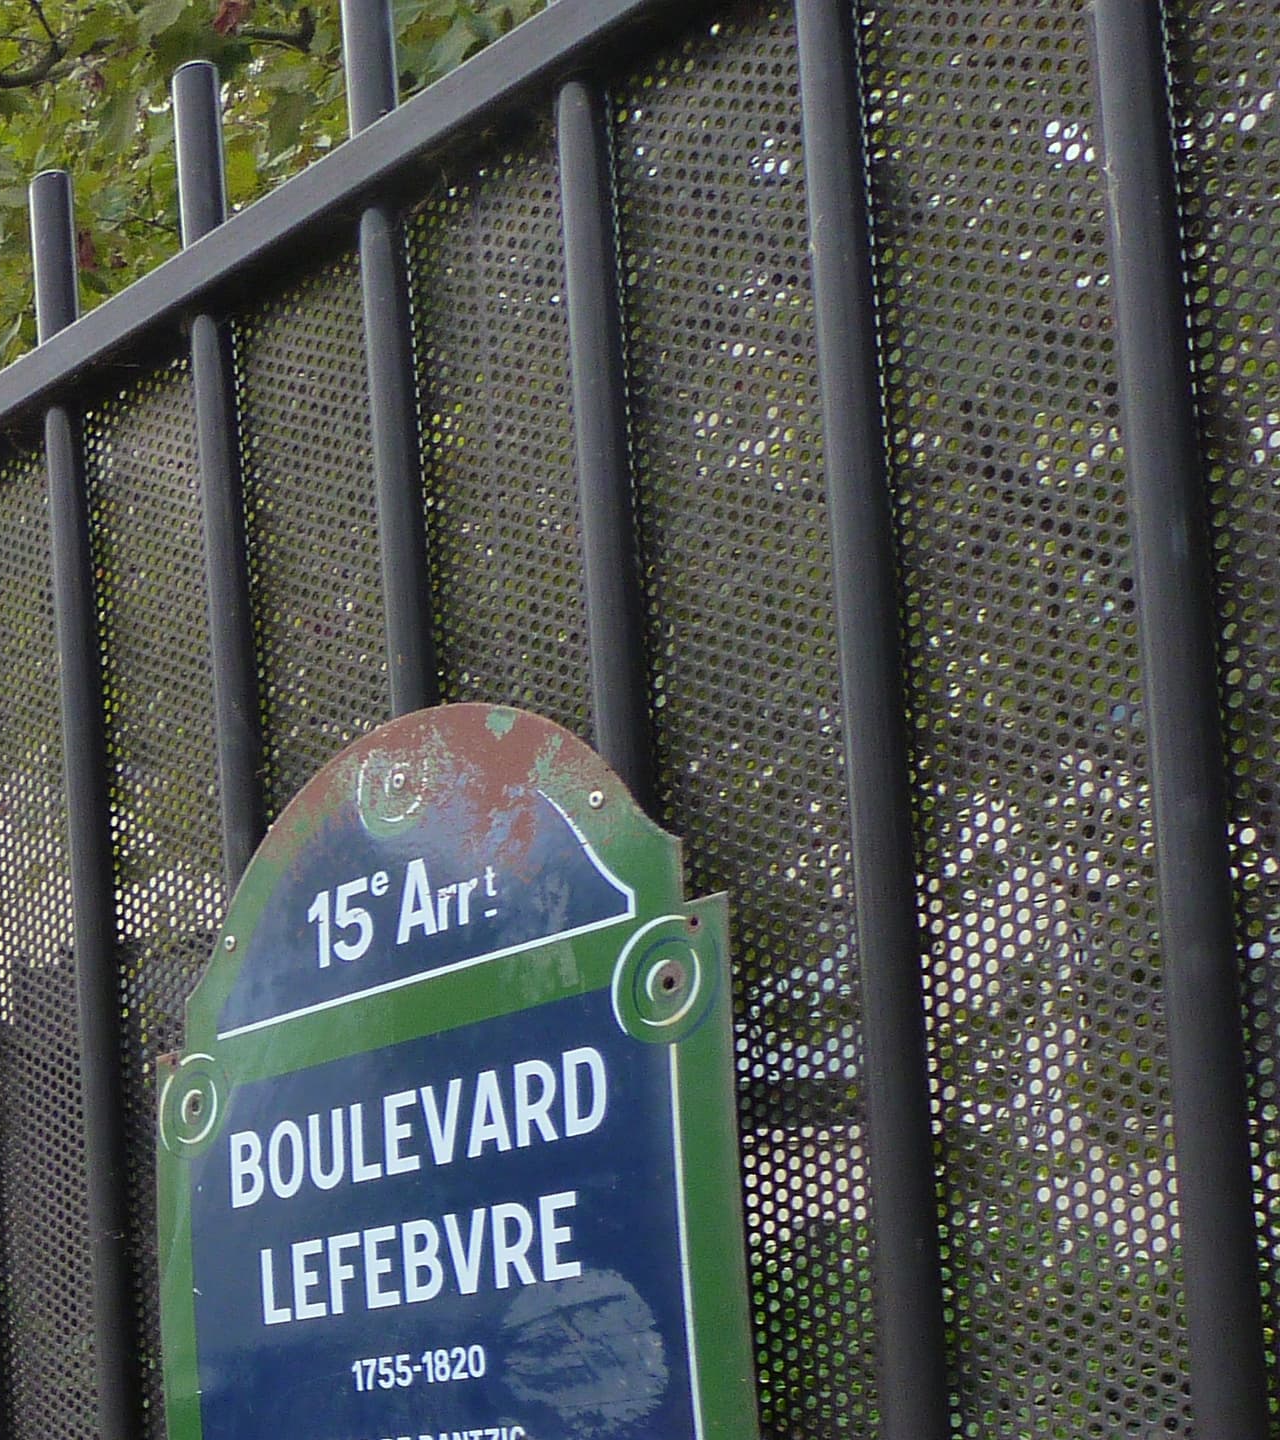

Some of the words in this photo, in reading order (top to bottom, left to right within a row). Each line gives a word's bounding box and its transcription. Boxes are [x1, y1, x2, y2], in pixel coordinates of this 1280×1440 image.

[307, 866, 389, 968] 15e
[228, 1045, 608, 1209] BOULEVARD
[260, 1191, 582, 1326] LEFEBVRE
[351, 1346, 486, 1392] 1755-1820
